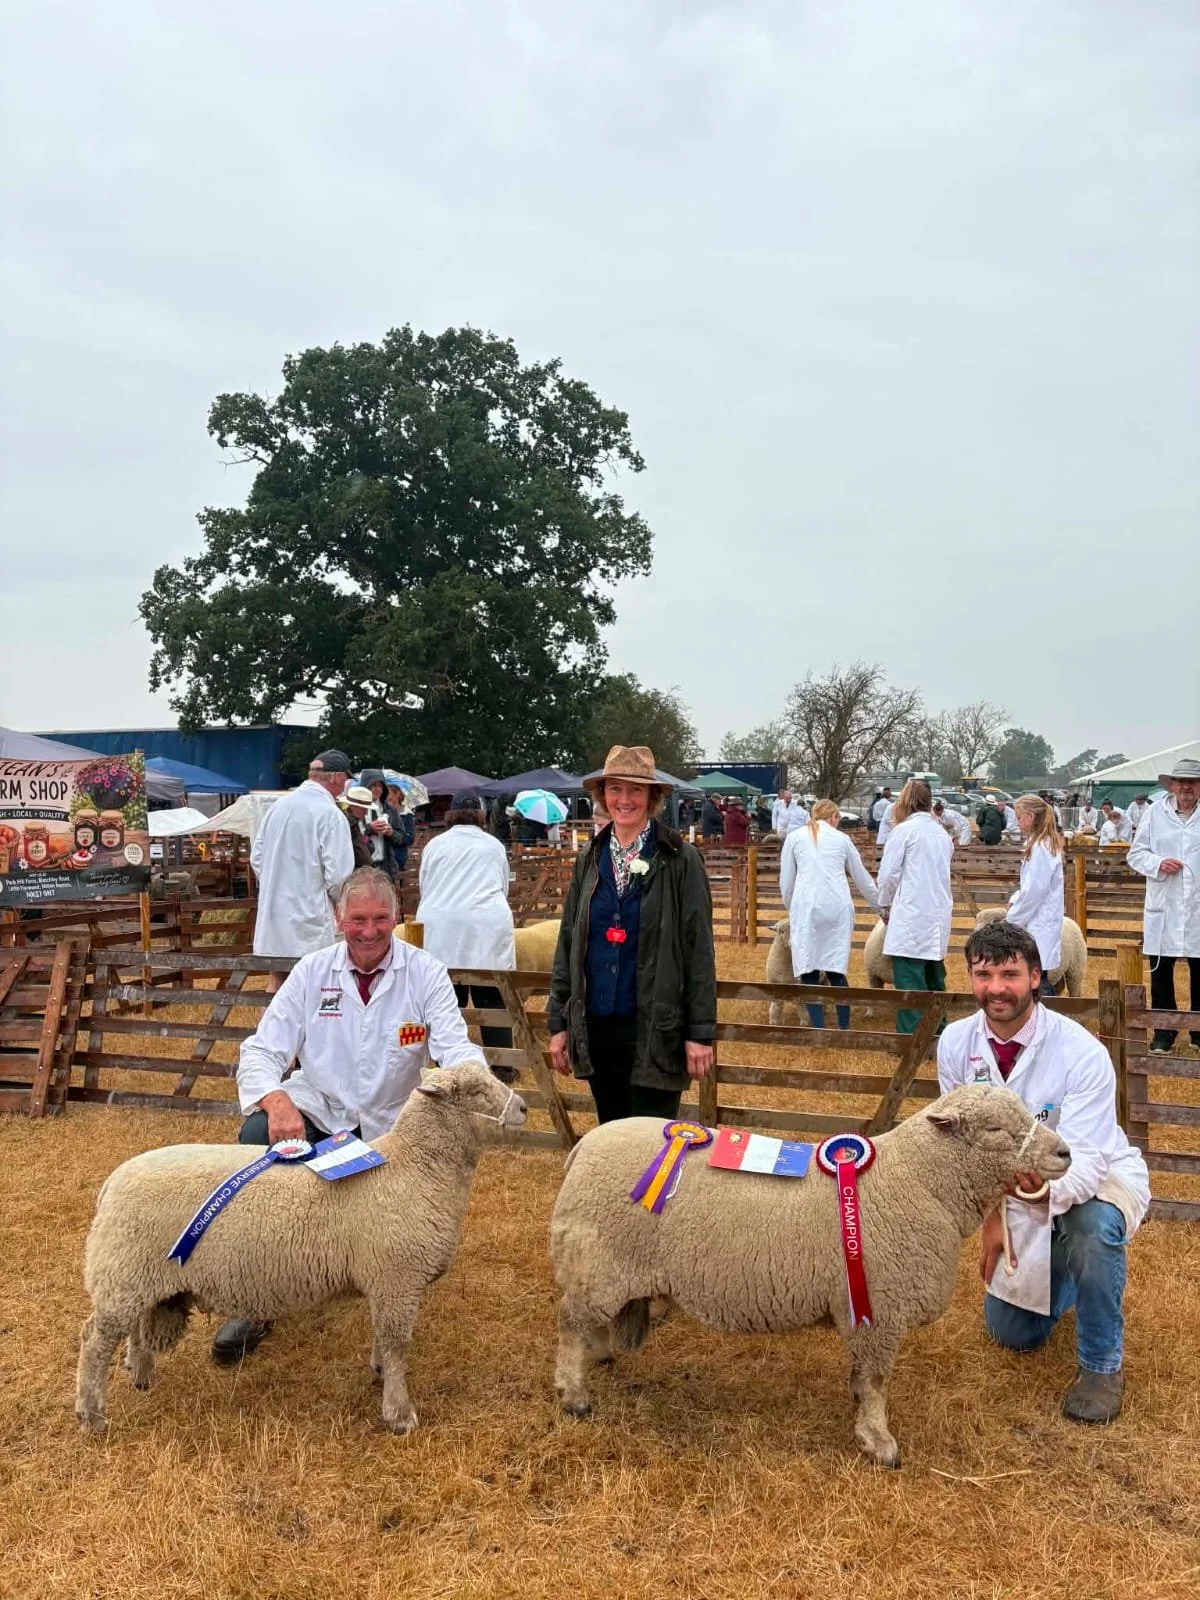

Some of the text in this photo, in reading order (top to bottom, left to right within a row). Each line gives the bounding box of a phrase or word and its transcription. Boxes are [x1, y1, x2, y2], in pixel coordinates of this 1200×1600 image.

[12, 810, 33, 818] LOCAL
[39, 811, 66, 819] QUALITY
[29, 780, 68, 801] SHOP
[190, 1158, 270, 1239] RESERVE CHAMPION
[843, 1186, 859, 1261] CHAMPION
